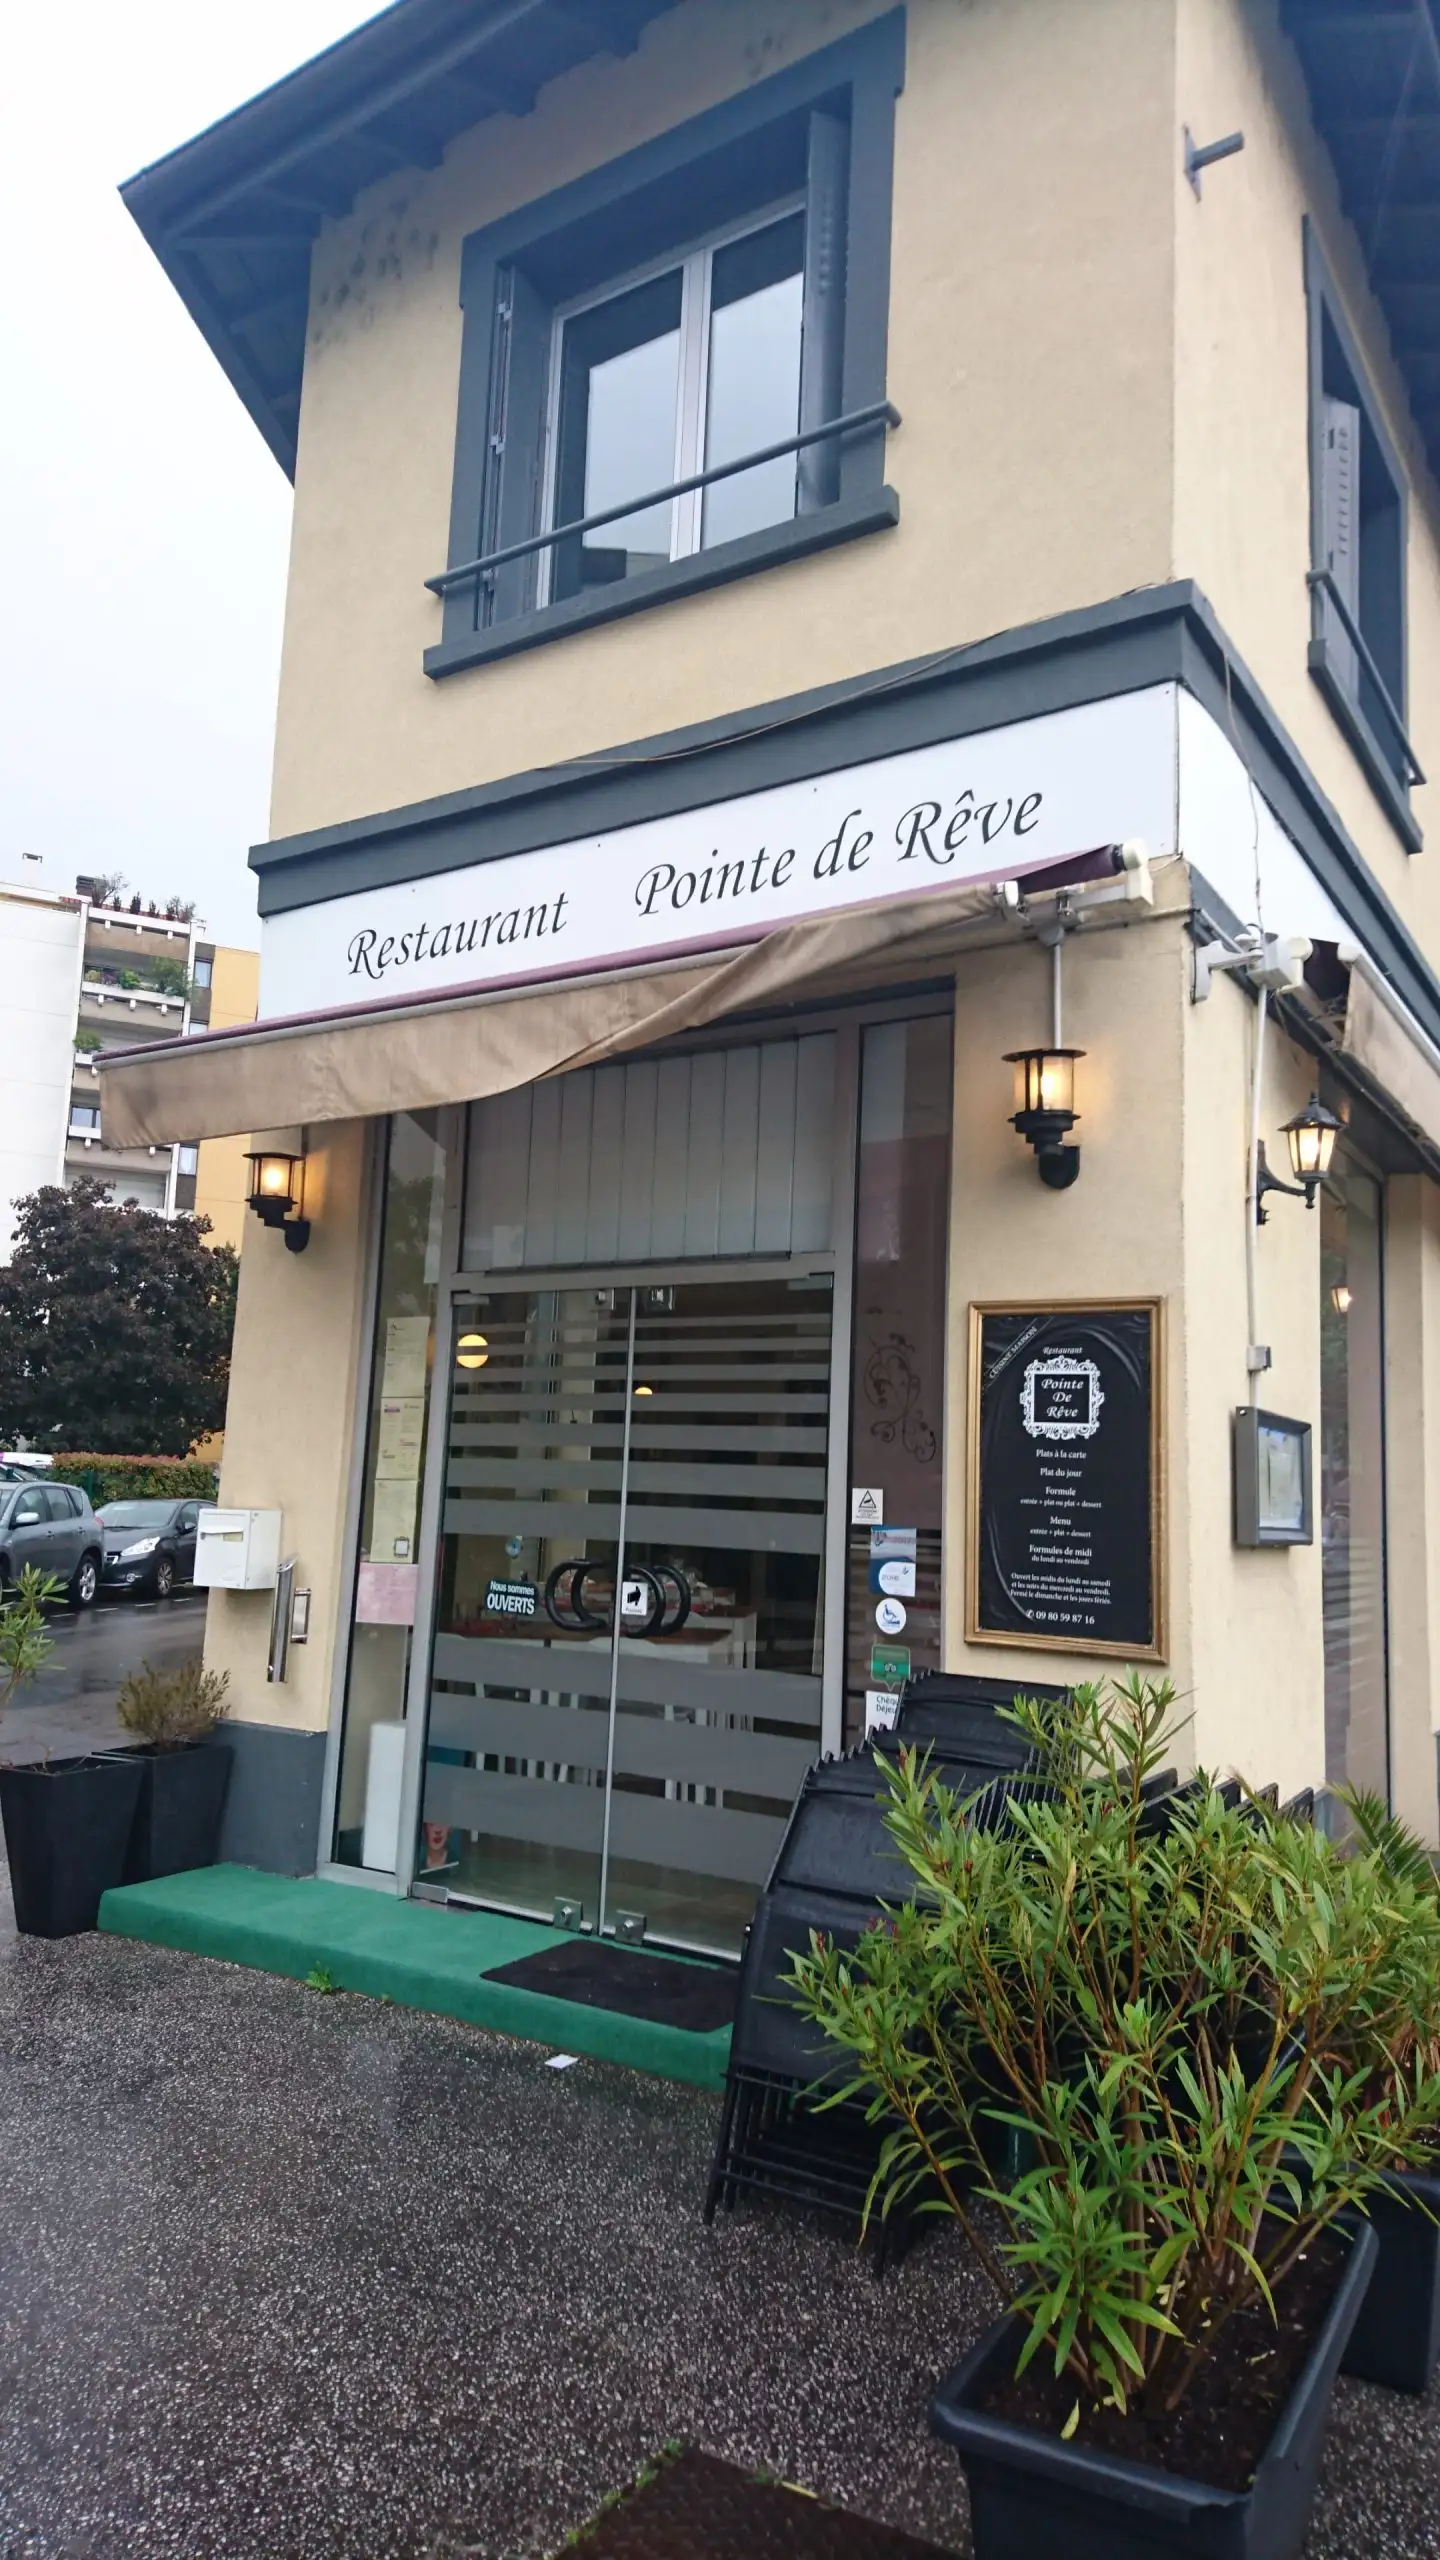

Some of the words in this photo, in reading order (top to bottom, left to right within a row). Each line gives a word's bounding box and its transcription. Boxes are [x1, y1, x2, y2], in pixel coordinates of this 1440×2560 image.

[635, 847, 796, 916] Pointe
[813, 809, 874, 879] de
[895, 789, 1043, 865] Rêve
[348, 892, 569, 980] Restaurant
[989, 1351, 1011, 1379] CUISINE
[1011, 1326, 1037, 1352] MAISON
[1042, 1346, 1083, 1355] Restaurant
[1041, 1378, 1085, 1390] Pointe
[1052, 1391, 1073, 1403] De
[1046, 1405, 1079, 1419] Rêve
[1036, 1449, 1053, 1458] Plats
[1054, 1449, 1059, 1458] à
[1060, 1450, 1067, 1459] la
[1068, 1451, 1087, 1460] carte
[1040, 1467, 1054, 1477] Plat
[1055, 1468, 1065, 1478] du
[1066, 1470, 1082, 1480] jour
[1045, 1486, 1076, 1496] Formule
[1043, 1499, 1055, 1507] plat
[1064, 1500, 1075, 1508] plat
[1081, 1500, 1102, 1509] dessert
[1049, 1516, 1072, 1525] Menu
[1053, 1529, 1065, 1537] plat
[1070, 1530, 1092, 1538] dessert
[1029, 1544, 1063, 1555] Formules
[1074, 1548, 1093, 1557] midi
[1031, 1554, 1040, 1562] du
[1040, 1555, 1056, 1563] lundi
[1064, 1558, 1090, 1566] vendredi
[1011, 1572, 1031, 1580] Ouvert
[1031, 1573, 1040, 1581] les
[1040, 1575, 1056, 1583] midis
[1065, 1576, 1081, 1584] lundi
[1090, 1579, 1111, 1587] samedi
[490, 1580, 507, 1592] Nous
[507, 1584, 535, 1596] sommes
[1017, 1581, 1026, 1589] les
[1049, 1585, 1075, 1593] mercredi
[1028, 1590, 1034, 1598] le
[1034, 1591, 1063, 1601] dimanche
[1069, 1593, 1078, 1602] les
[1078, 1595, 1094, 1603] jours
[486, 1593, 535, 1615] OUVERTS
[1035, 1610, 1047, 1620] 09
[1047, 1611, 1059, 1621] 80
[1059, 1612, 1071, 1622] 59
[1071, 1613, 1083, 1624] 87
[1085, 1614, 1095, 1625] 16
